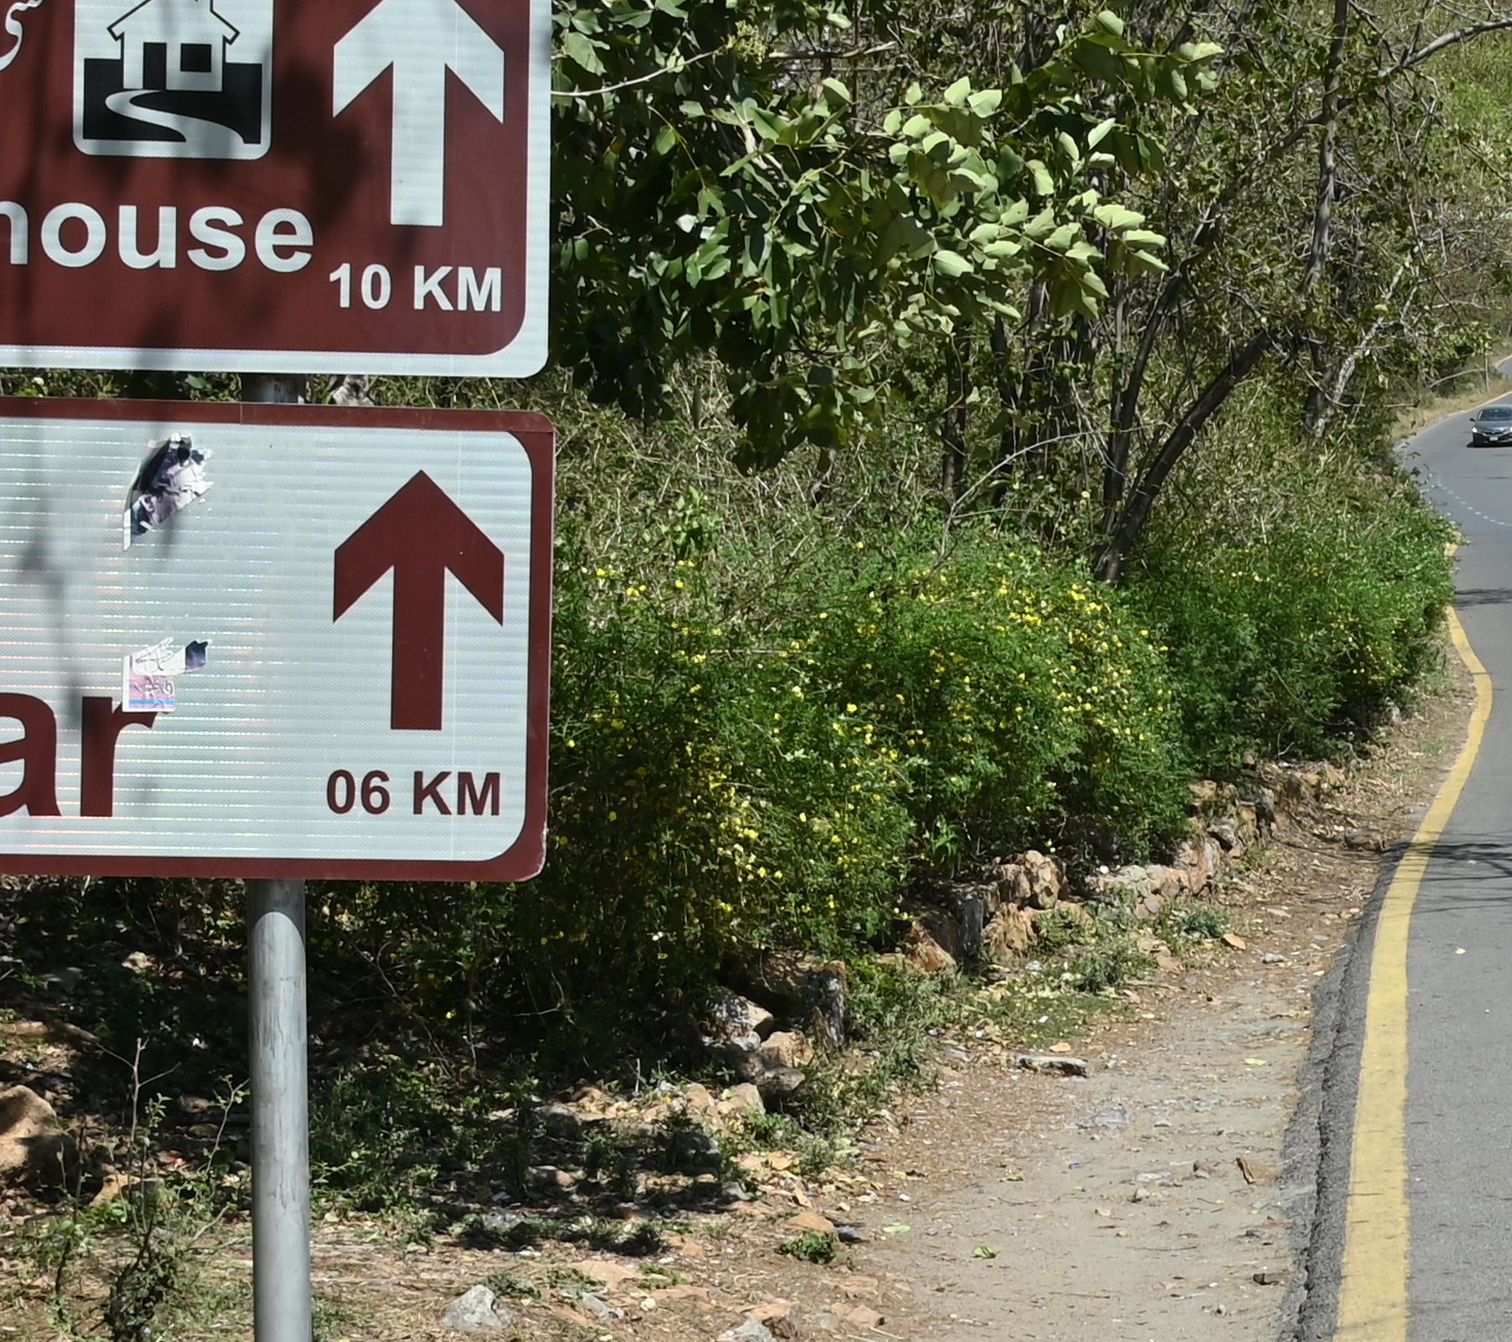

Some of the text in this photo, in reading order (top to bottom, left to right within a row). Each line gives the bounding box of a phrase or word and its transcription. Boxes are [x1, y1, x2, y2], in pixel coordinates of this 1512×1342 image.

[329, 263, 502, 312] 10 KM
[326, 759, 500, 816] 06 KM
